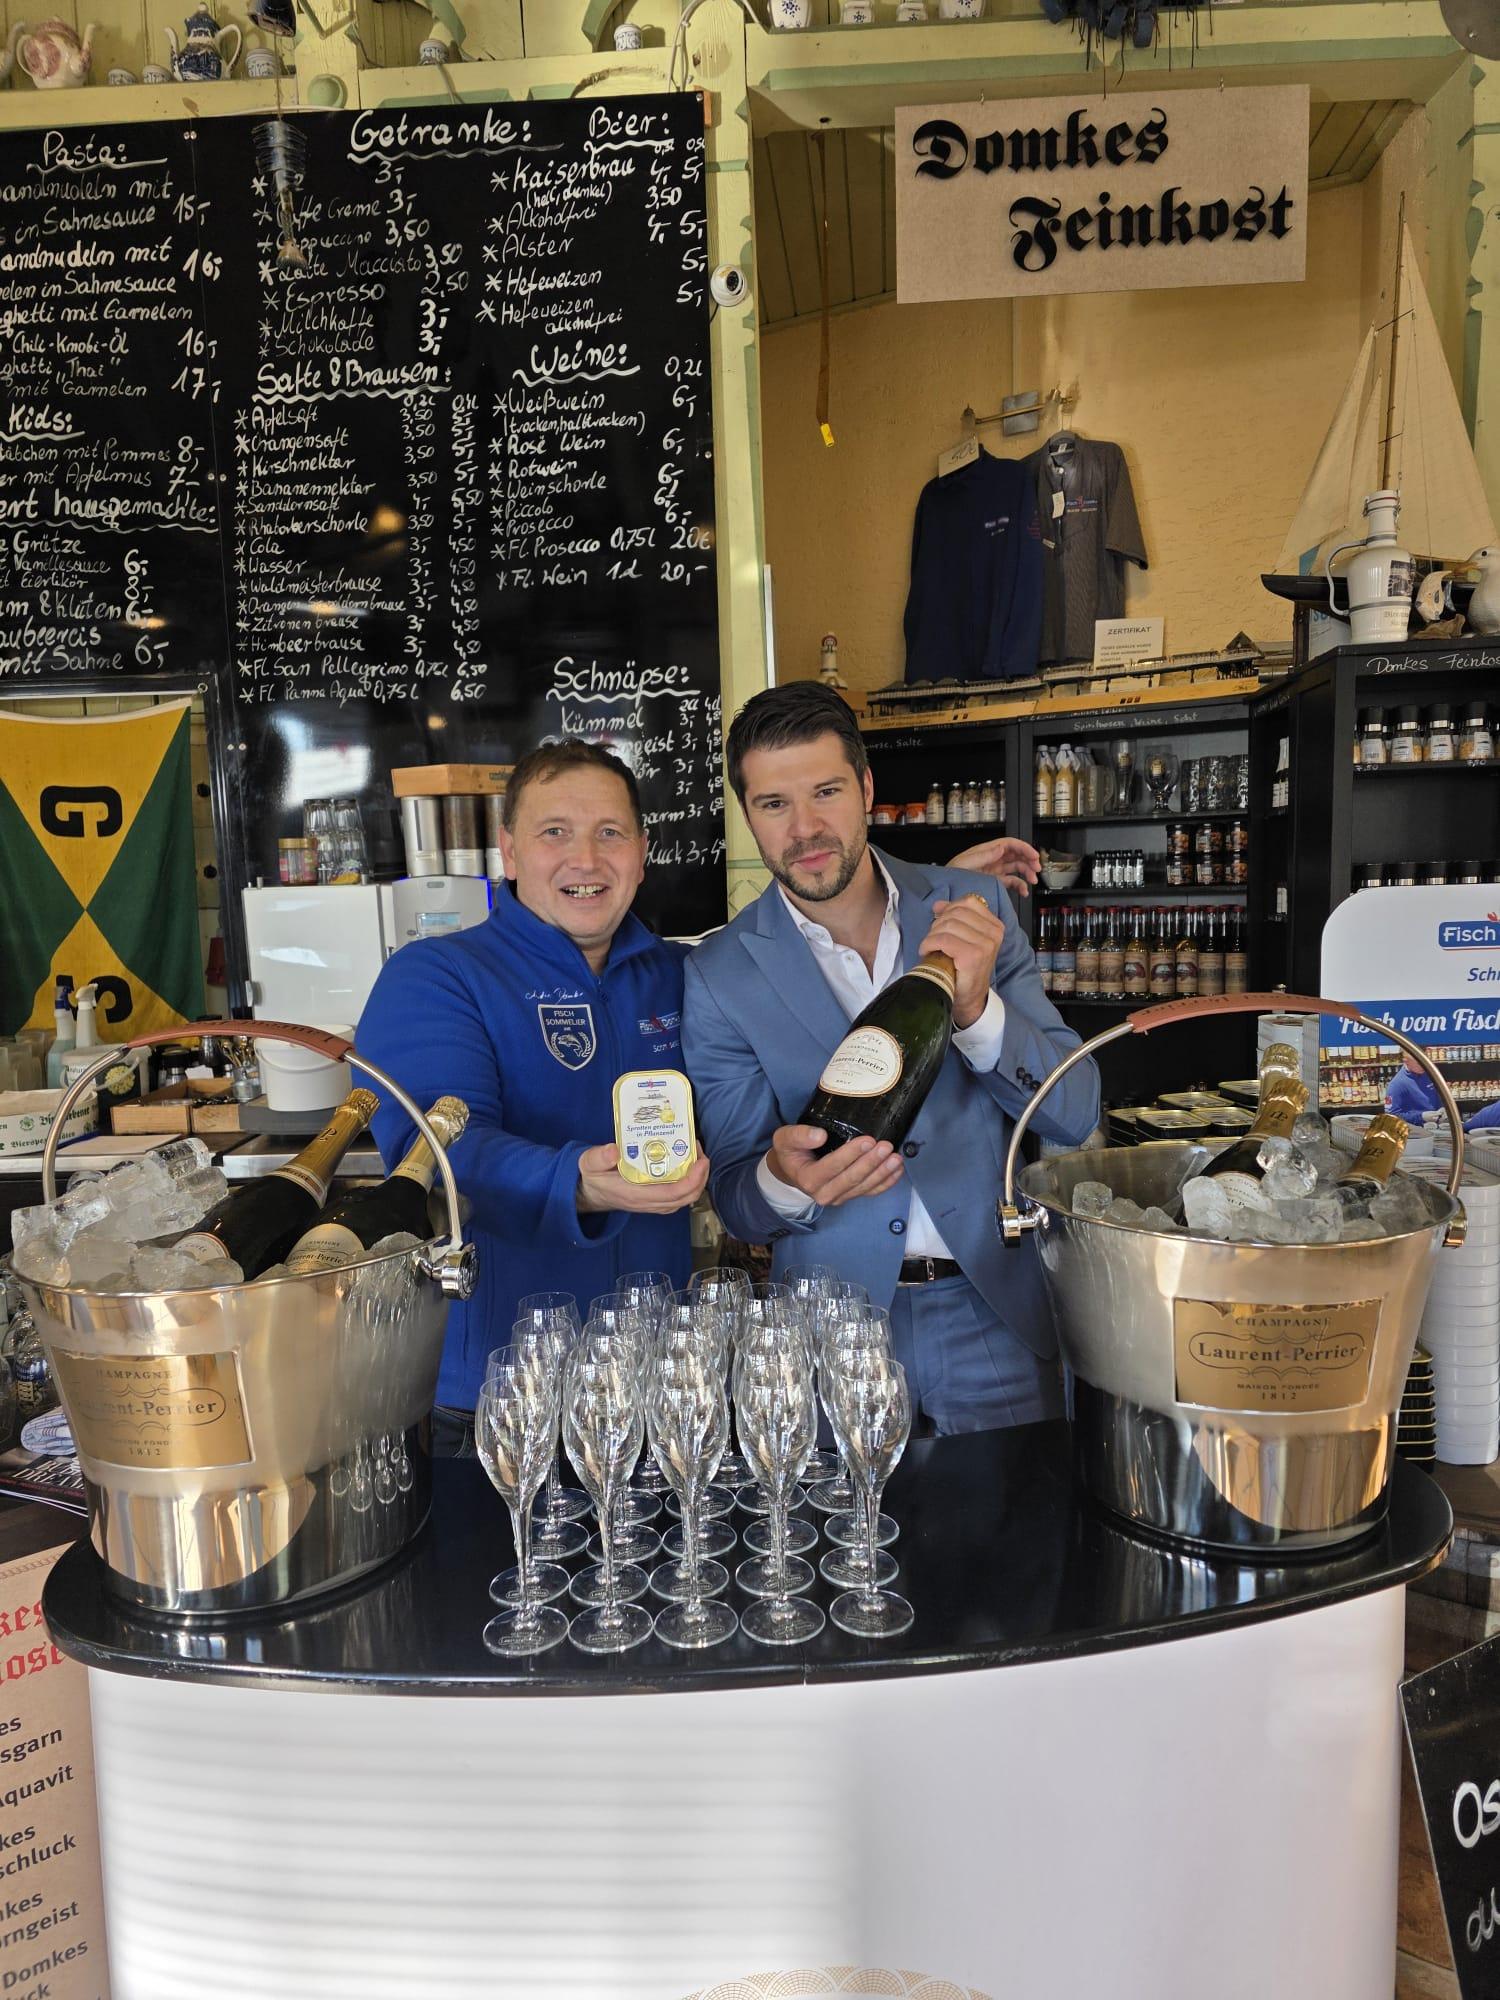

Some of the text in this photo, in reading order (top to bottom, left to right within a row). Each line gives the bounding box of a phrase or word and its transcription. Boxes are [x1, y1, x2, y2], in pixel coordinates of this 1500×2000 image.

[589, 106, 669, 138] Bier:
[43, 131, 128, 166] Pasta:
[912, 107, 1169, 180] Domkes
[0, 170, 174, 201] andnudeln mit
[42, 205, 156, 235] Sahnesauce
[1008, 184, 1293, 272] Feinkost
[0, 240, 115, 271] andnudeln
[124, 236, 173, 263] mit
[503, 232, 574, 263] Alster
[0, 270, 176, 301] elen in Sahnesauce
[286, 283, 386, 312] Espresso
[506, 267, 602, 305] Hefeweizen
[0, 302, 54, 338] ghetti
[61, 301, 98, 323] mit
[501, 298, 594, 329] Hefeweizen
[275, 332, 375, 358] Schokolade
[530, 339, 628, 376] Weine:
[0, 354, 52, 388] ghetti
[8, 377, 147, 398] mit Garnelen
[508, 387, 605, 414] Weißwein
[8, 403, 73, 433] Kids:
[252, 402, 319, 434] Apfelsaft
[63, 440, 100, 460] mit
[103, 437, 171, 463] Pommes
[252, 427, 349, 456] Orangensaft
[560, 432, 606, 452] Wein
[24, 462, 152, 492] mit Apfelmus
[508, 458, 578, 480] Rotwein
[507, 470, 607, 500] Weinschorle
[0, 488, 39, 519] ert
[505, 497, 554, 521] Piccolo
[506, 515, 574, 539] Prosecco
[13, 529, 86, 555] Grütze
[250, 540, 285, 555] Cola
[534, 535, 601, 558] Prosecco
[21, 571, 88, 588] Eierlikör
[249, 558, 307, 576] Wasser
[542, 563, 588, 585] Wein
[0, 615, 101, 650] aubeereis
[1107, 626, 1152, 635] ZERTIFIKAT
[51, 645, 124, 671] Sahne
[273, 656, 312, 677] San
[321, 654, 409, 689] Pellegrino
[1366, 657, 1429, 675] Domkes
[553, 656, 690, 708] Schnäpse:
[561, 706, 645, 734] Kümmel
[1443, 925, 1497, 943] Fisch
[545, 1018, 586, 1026] SOMMELIER
[553, 1010, 575, 1018] FISCH
[1401, 1015, 1446, 1032] vom
[1235, 1316, 1331, 1327] CHAMPAGNE
[1198, 1342, 1358, 1363] Laurent-Perrier
[1262, 1392, 1298, 1400] 1812
[0, 1728, 62, 1763] sgarn
[0, 1825, 36, 1851] kes
[0, 1834, 76, 1880] schluck
[0, 1892, 43, 1923] kes
[2, 1940, 88, 1990] Domkes
